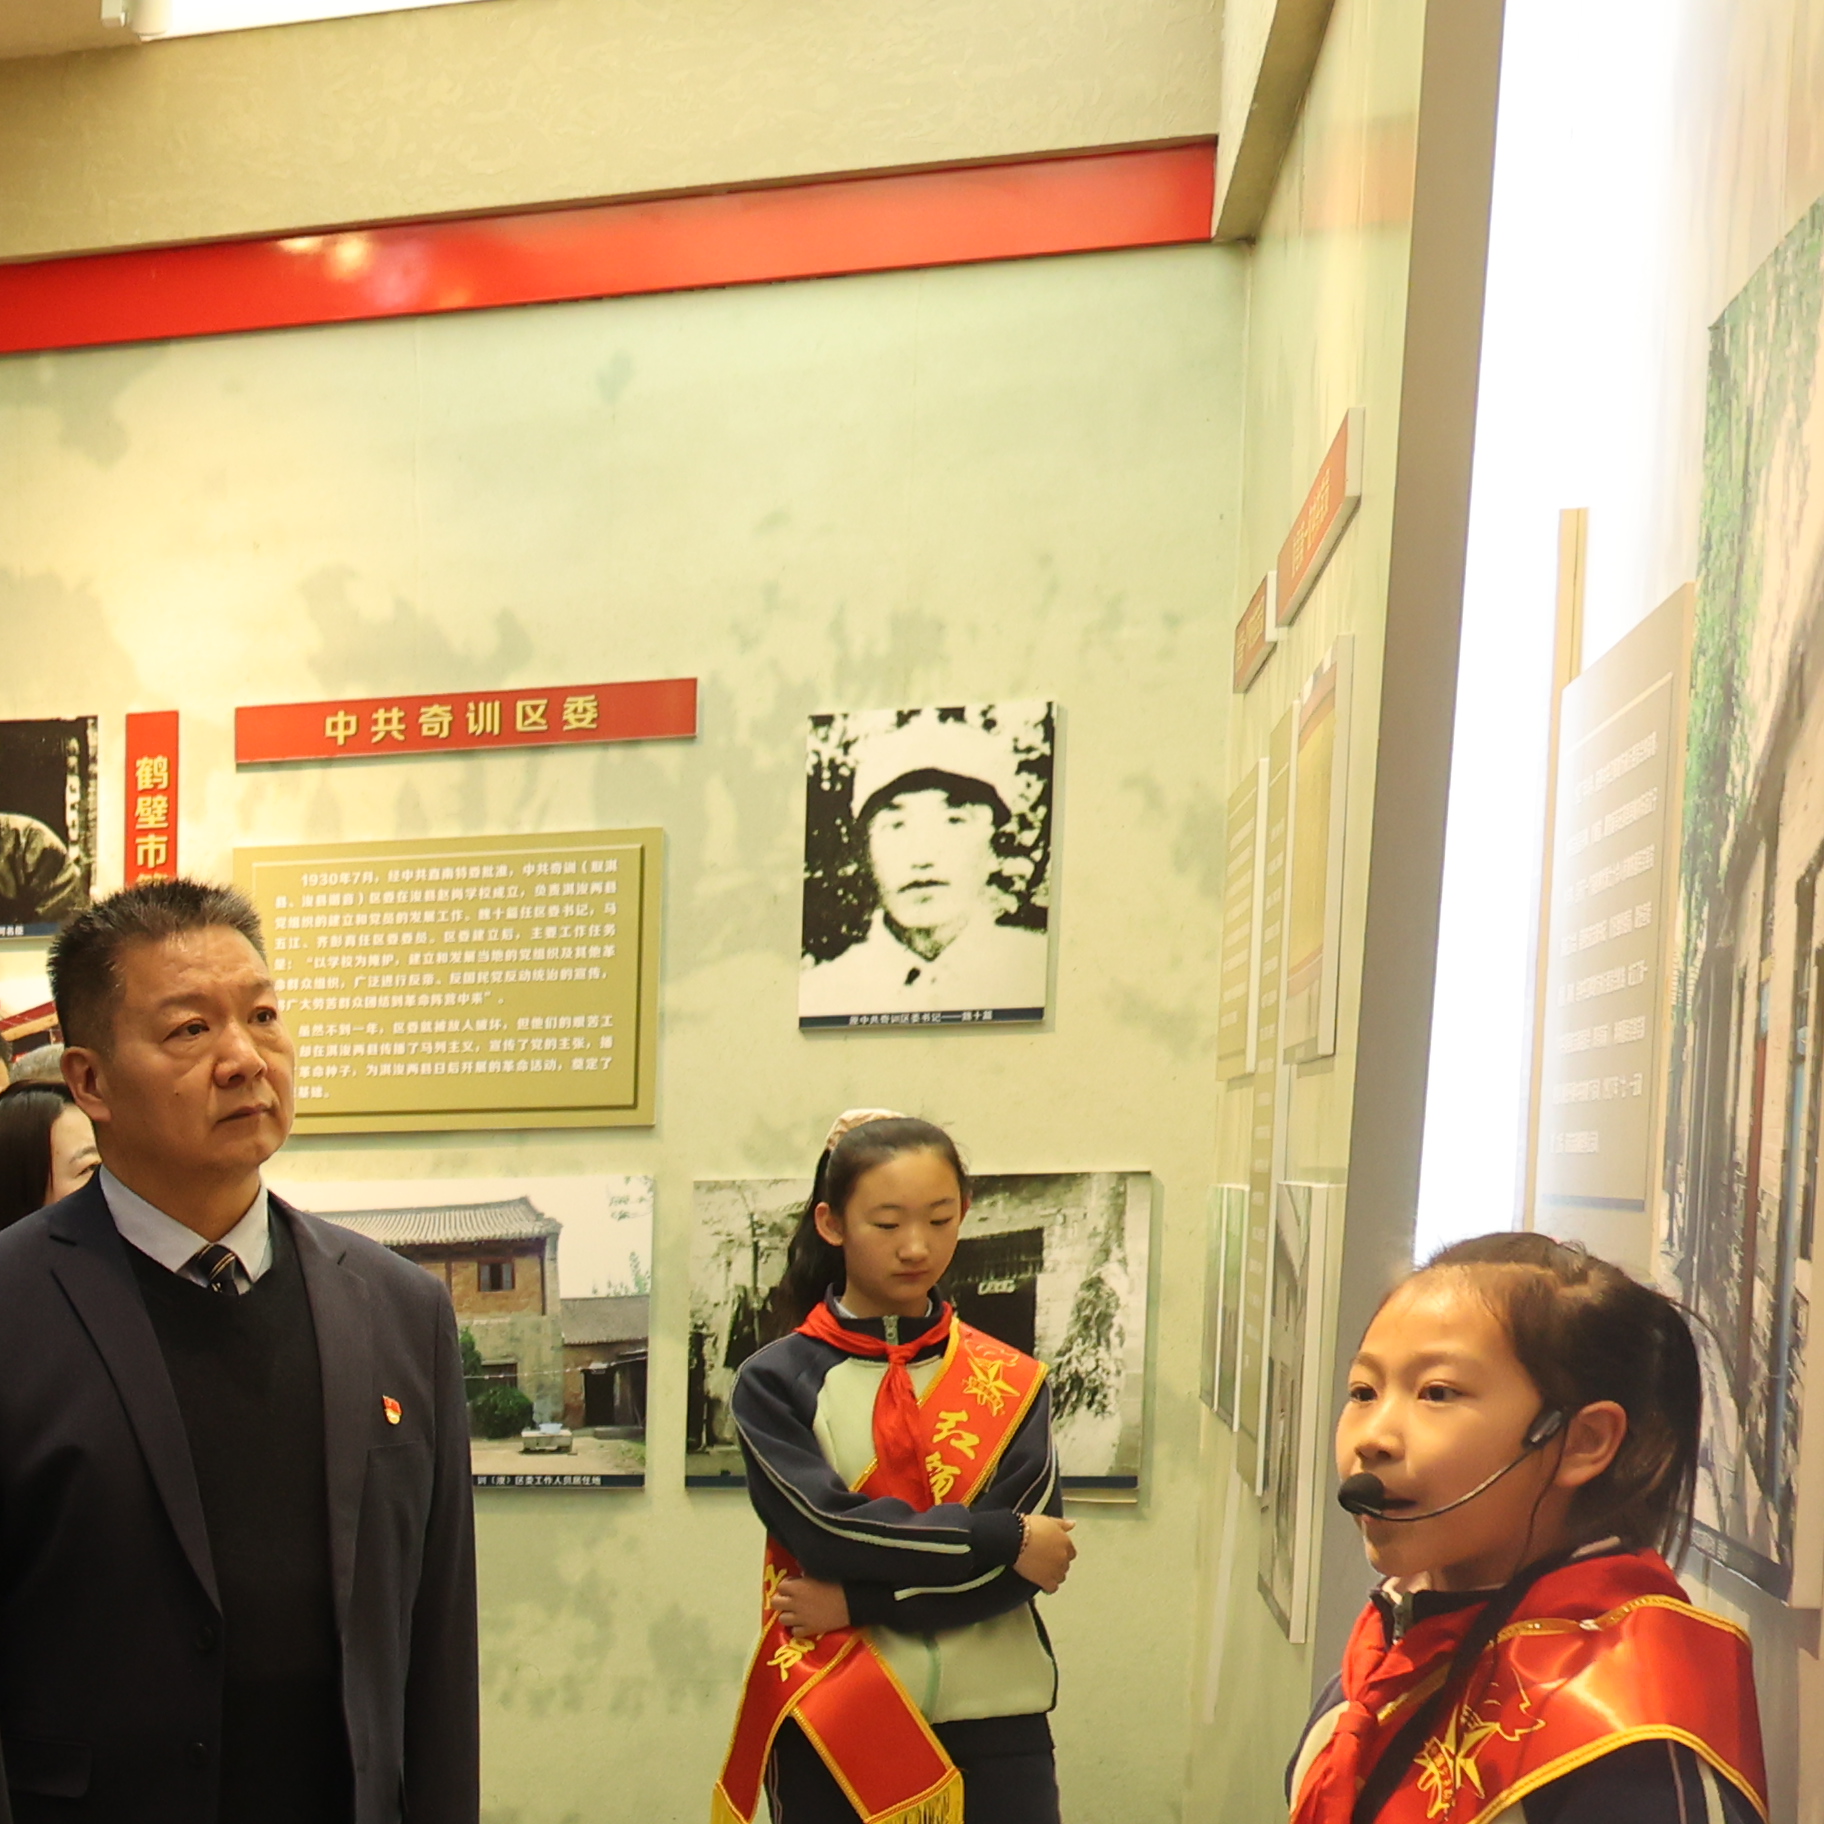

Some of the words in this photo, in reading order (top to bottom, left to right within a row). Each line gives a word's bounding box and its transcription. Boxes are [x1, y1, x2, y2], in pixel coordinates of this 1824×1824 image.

[324, 695, 599, 746] 中共奇训区委
